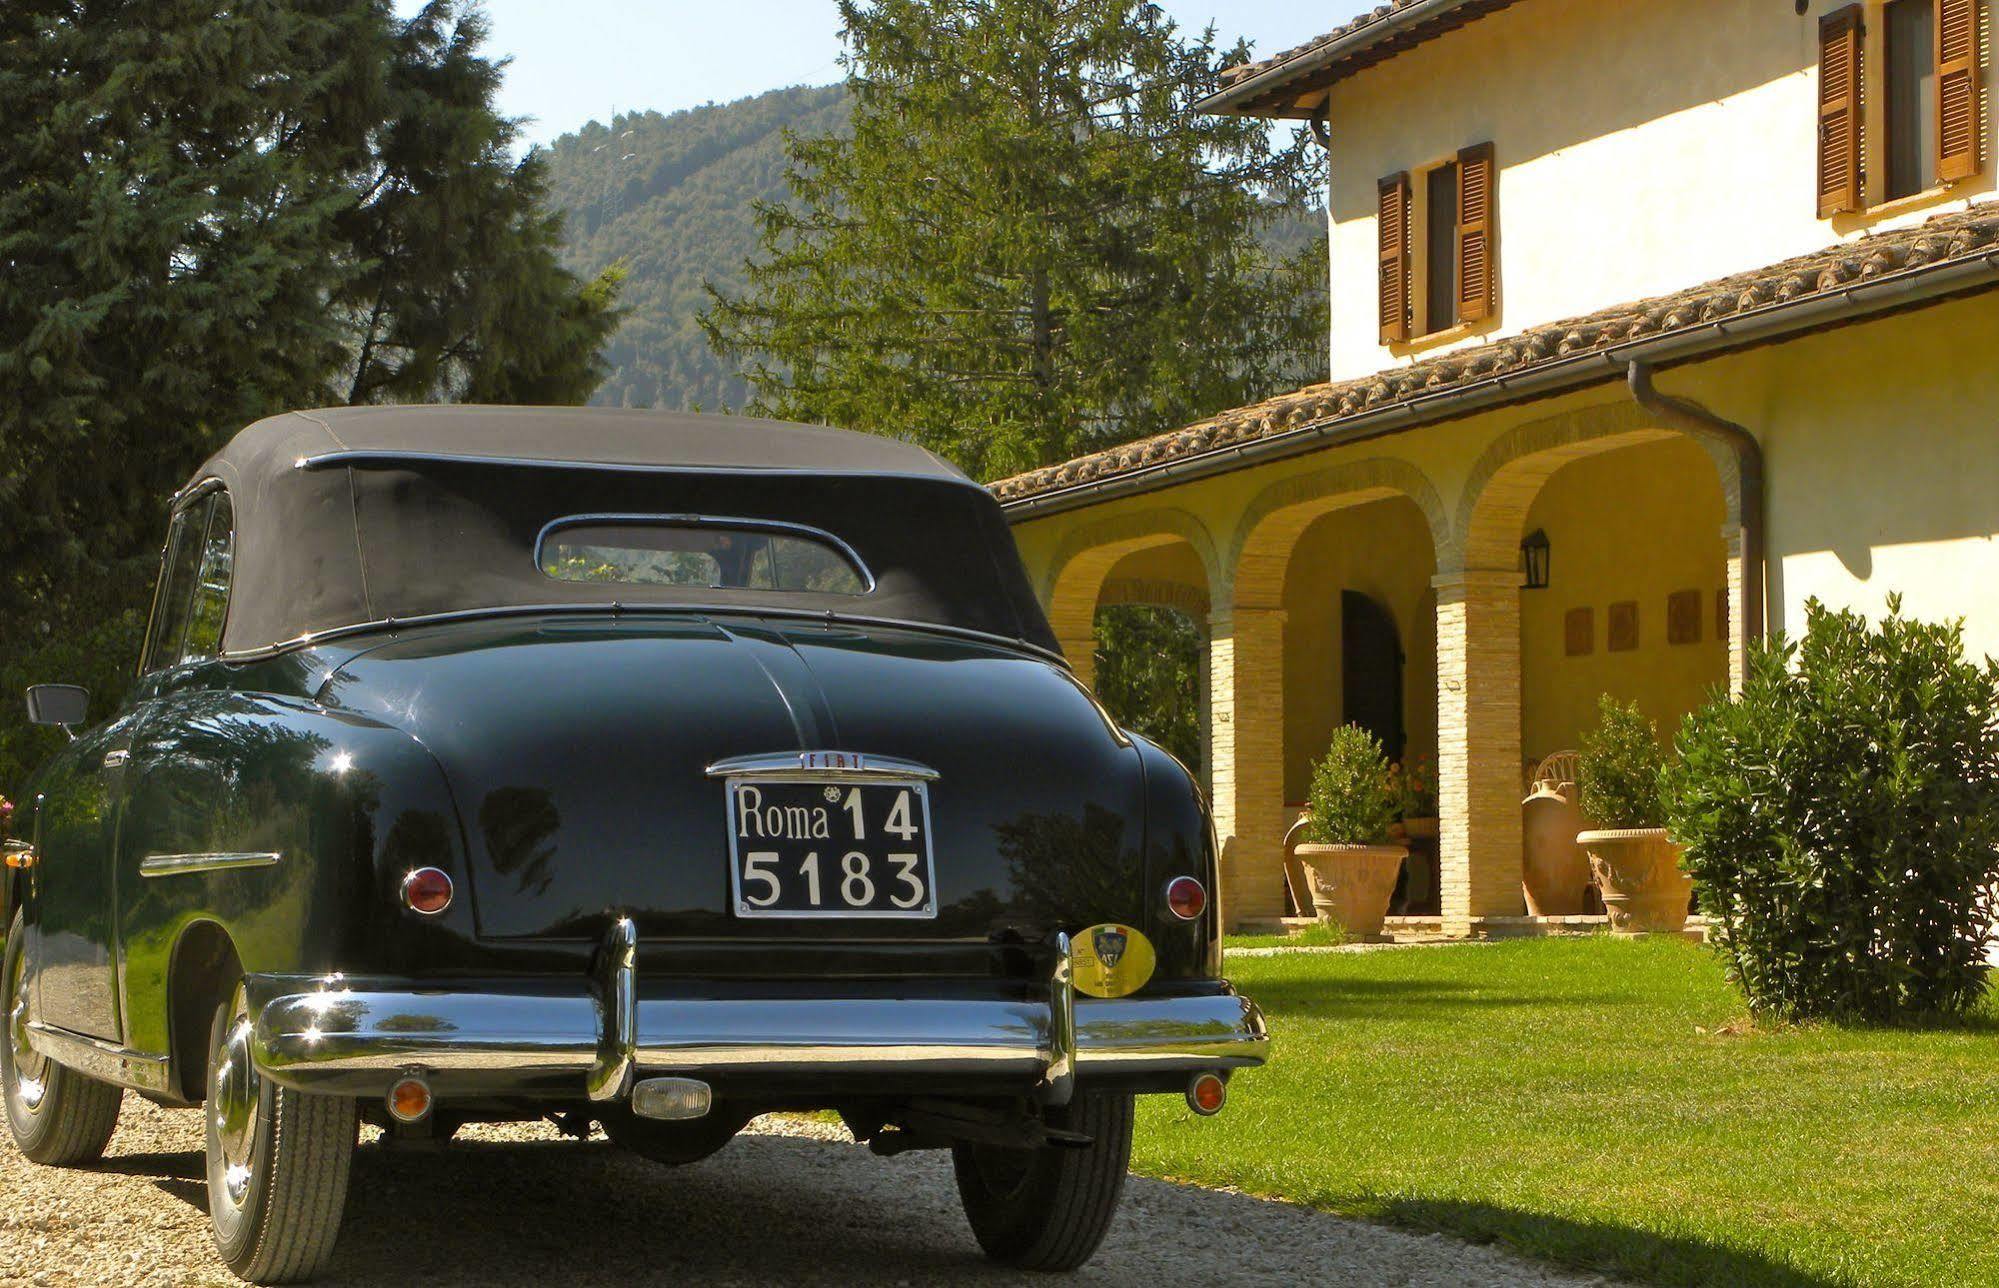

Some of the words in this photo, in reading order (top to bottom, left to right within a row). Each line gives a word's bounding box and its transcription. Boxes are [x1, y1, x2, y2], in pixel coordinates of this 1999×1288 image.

[809, 753, 858, 768] FIAT
[738, 785, 830, 839] Roma
[743, 851, 925, 908] 5183
